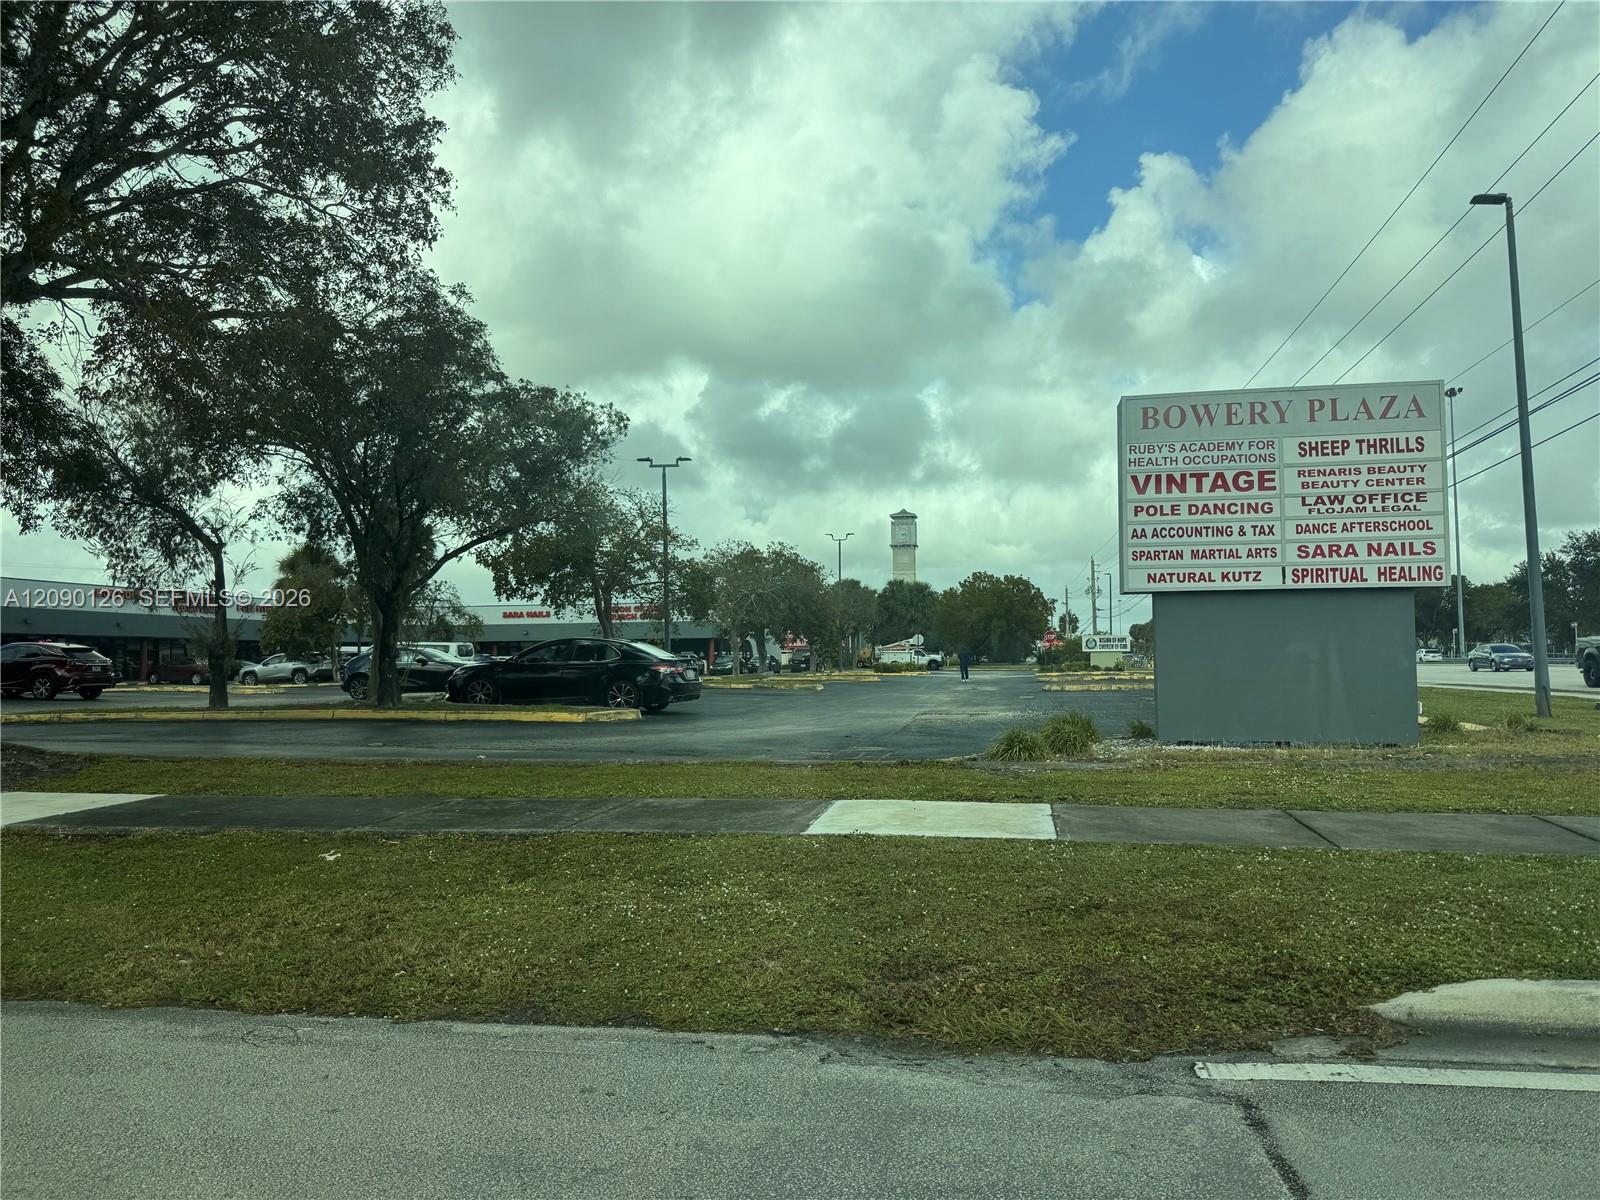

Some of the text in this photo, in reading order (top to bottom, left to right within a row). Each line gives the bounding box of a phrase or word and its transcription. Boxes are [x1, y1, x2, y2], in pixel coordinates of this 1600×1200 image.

[1139, 394, 1427, 431] BOWERY PLAZA
[1128, 440, 1276, 454] RUBY'S ACADEMY FOR
[1297, 435, 1425, 458] SHEEP THRILLS
[1128, 453, 1276, 467] HEALTH OCCUPATIONS
[1297, 464, 1428, 478] RENARIS BEAUTY
[1130, 470, 1277, 496] VINTAGE
[1301, 477, 1426, 490] BEAUTY CENTER
[1301, 492, 1428, 507] LAW OFFICE
[1133, 502, 1274, 517] POLE DANCING
[1308, 504, 1422, 515] FLOJAM LEGAL
[1131, 524, 1276, 540] AA ACCOUNTING & TAX
[1295, 519, 1434, 535] DANCE AFTERSCHOOL
[1131, 547, 1278, 561] SPARTAN MARTIAL ARTS
[1296, 541, 1437, 559] SARA NAILS
[1147, 571, 1262, 584] NATURAL KUTZ
[1291, 565, 1444, 584] SPIRITUAL HEALING
